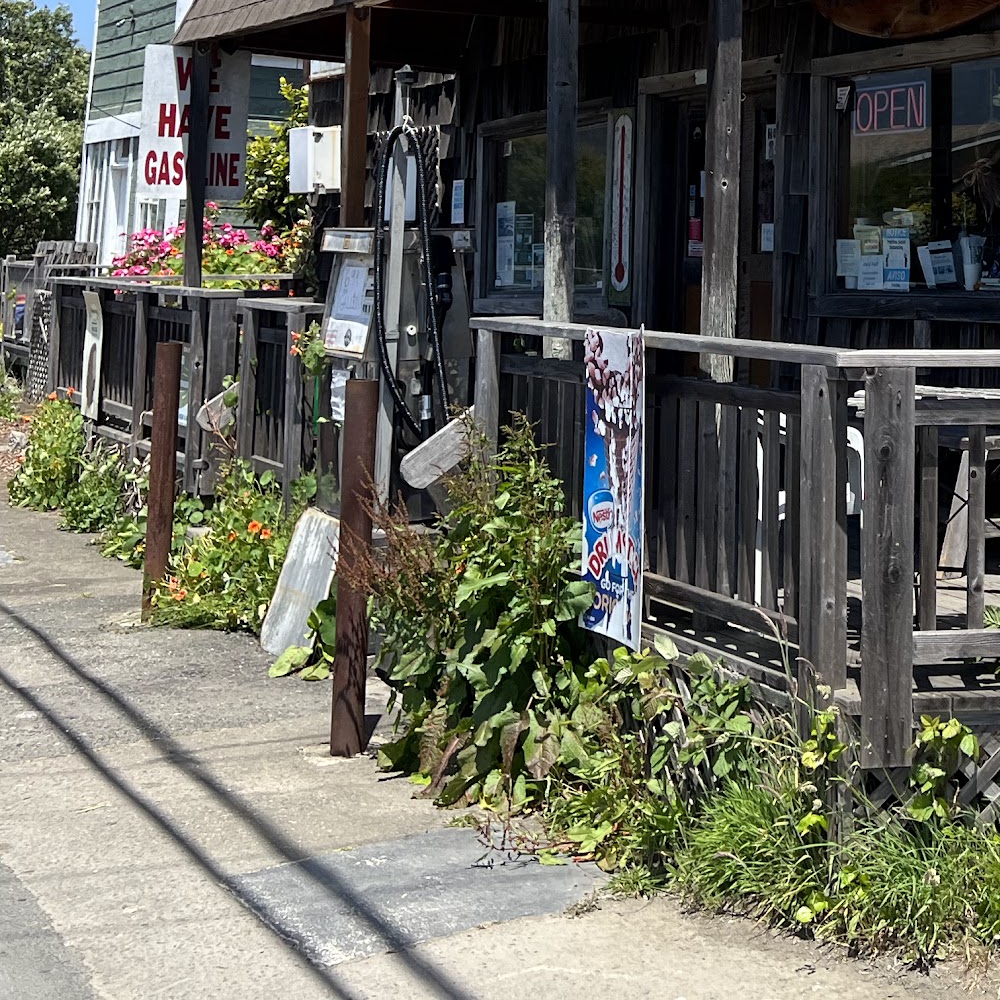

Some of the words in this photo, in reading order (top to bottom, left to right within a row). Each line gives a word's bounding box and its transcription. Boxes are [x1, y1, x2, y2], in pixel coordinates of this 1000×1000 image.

[856, 86, 923, 132] OPEN
[144, 150, 240, 187] GASINE
[887, 271, 906, 281] AVISO
[600, 578, 612, 591] GO
